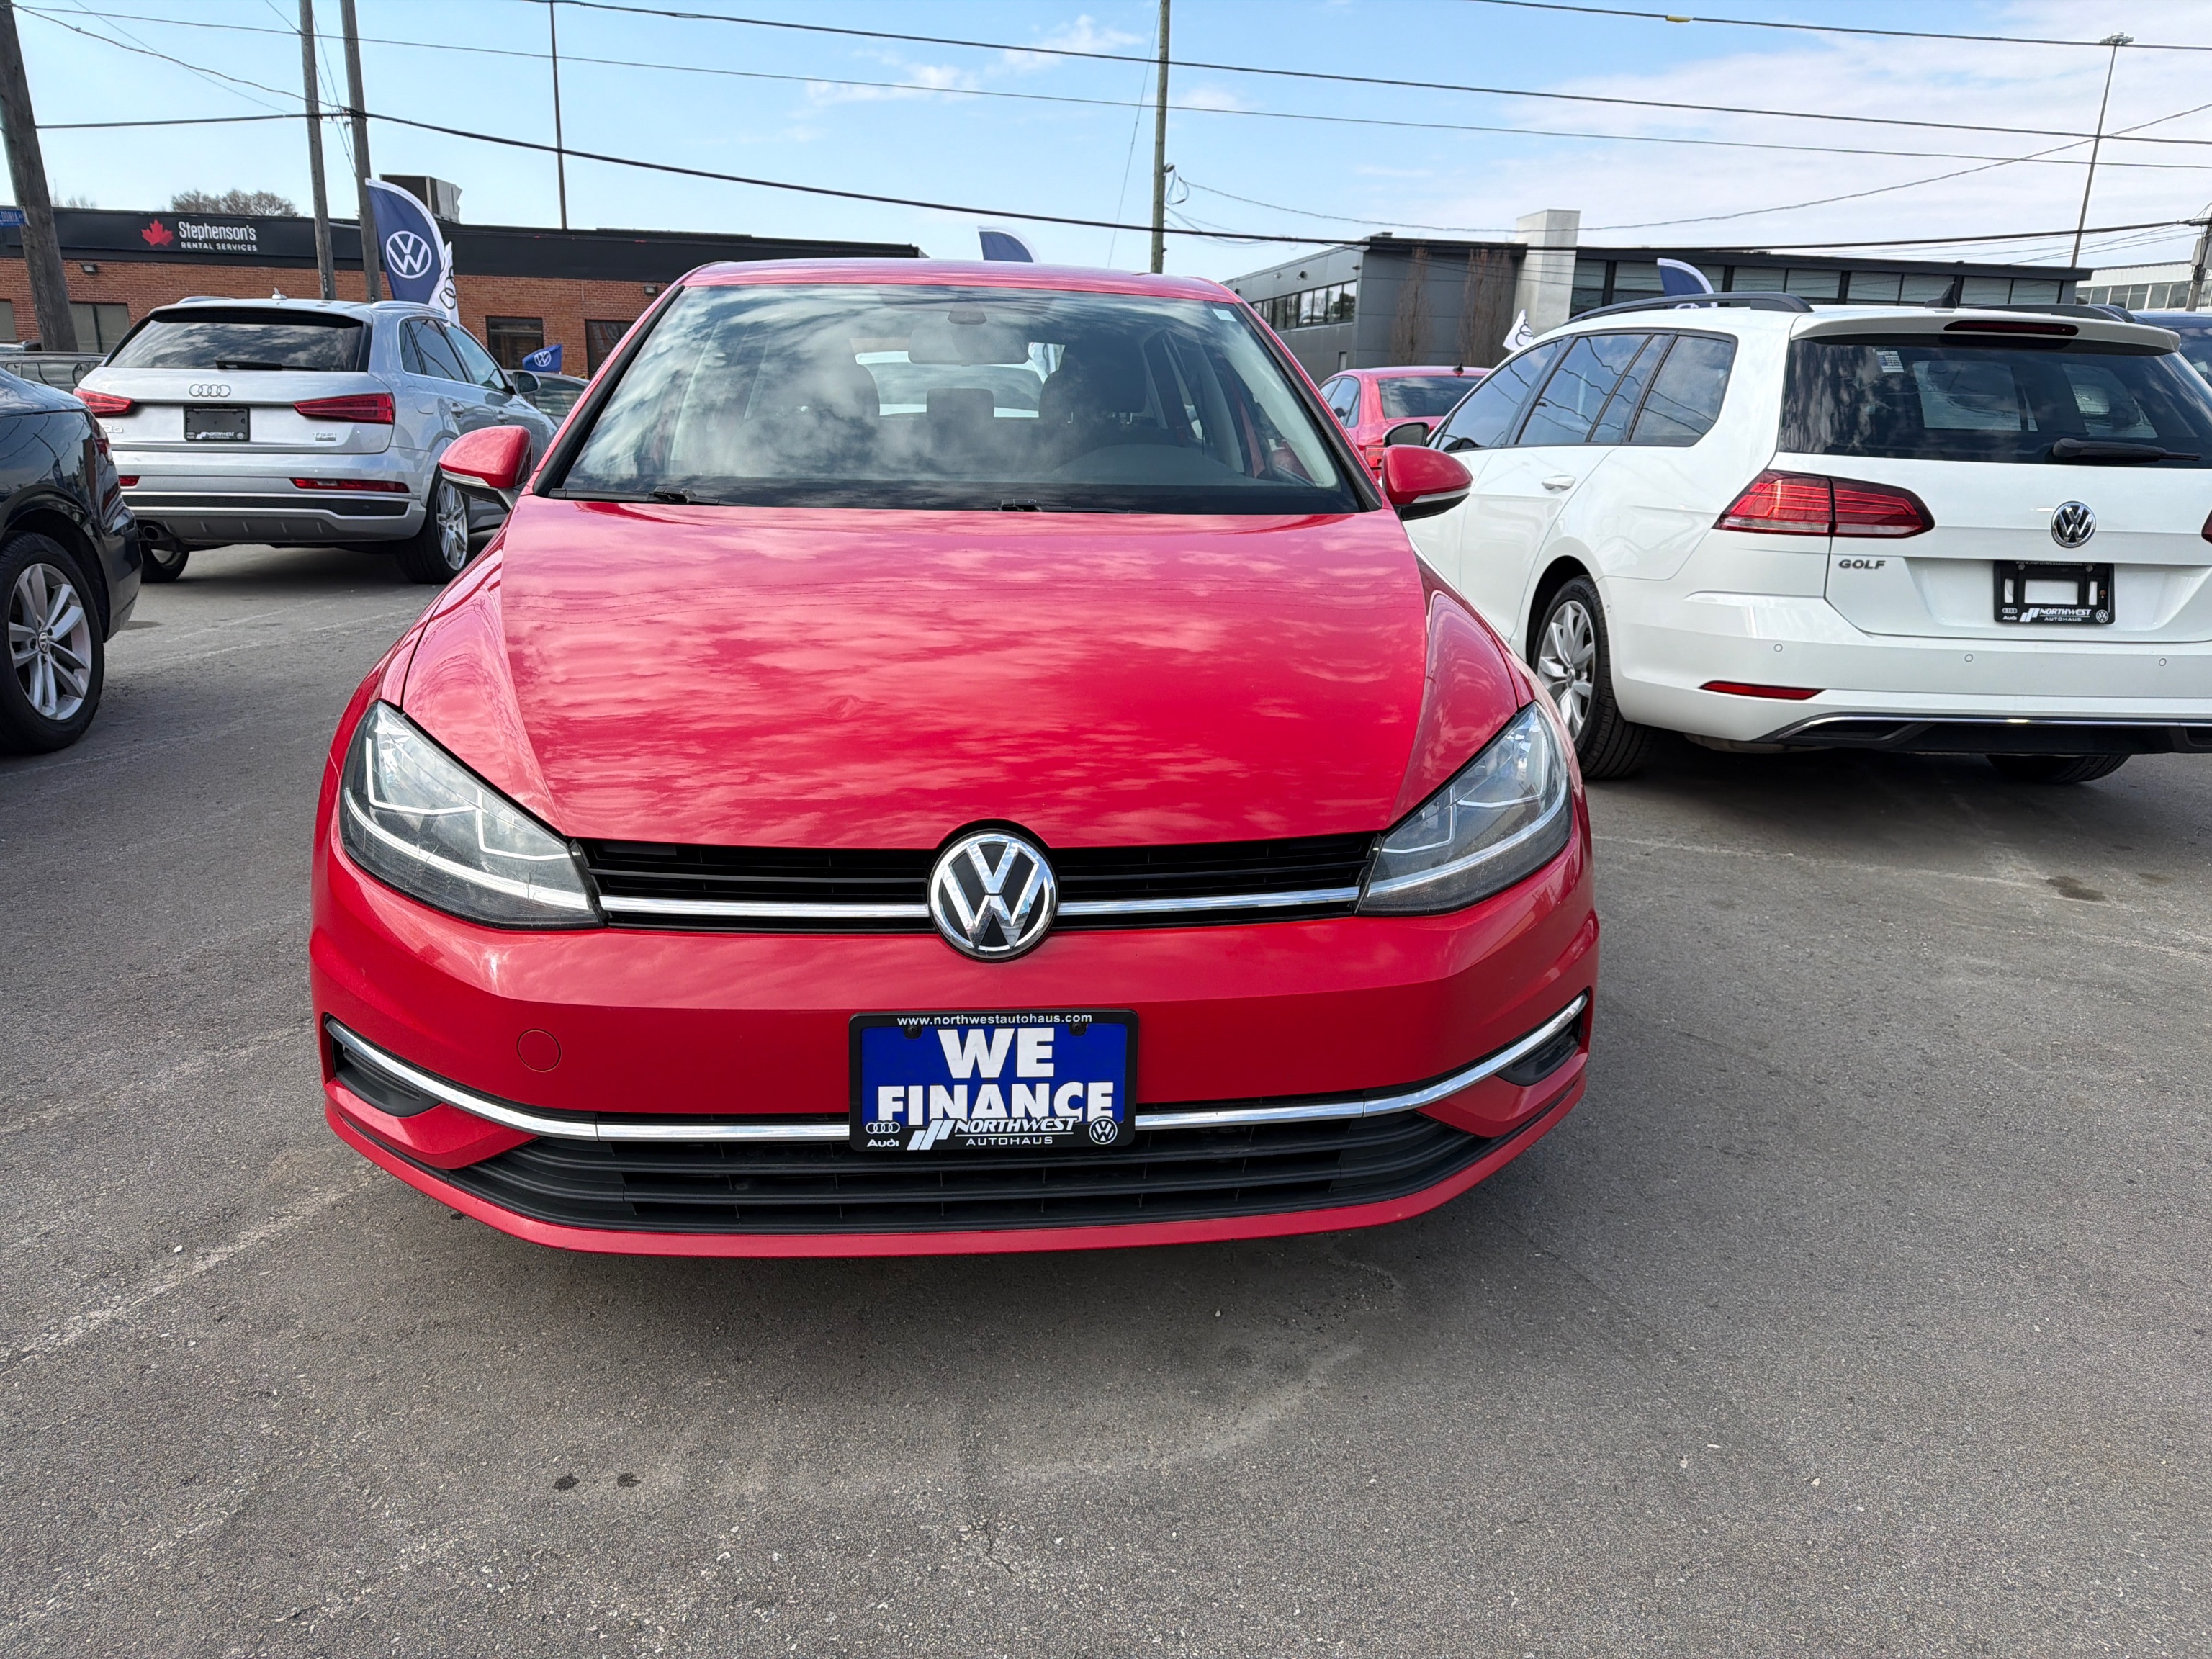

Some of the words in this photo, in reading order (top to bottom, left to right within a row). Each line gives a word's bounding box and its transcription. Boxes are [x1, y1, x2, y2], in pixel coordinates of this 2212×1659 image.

[178, 221, 256, 241] Stephenson's
[216, 243, 257, 251] SERVICES
[1838, 559, 1887, 570] GOLF
[896, 1013, 1093, 1026] www.northwestautohaus.com
[937, 1027, 1055, 1079] WE
[877, 1081, 1115, 1125] FINANCE
[954, 1117, 1078, 1133] NORTHWEST
[866, 1138, 900, 1148] Audi
[966, 1136, 1053, 1146] AUTOHAUS
